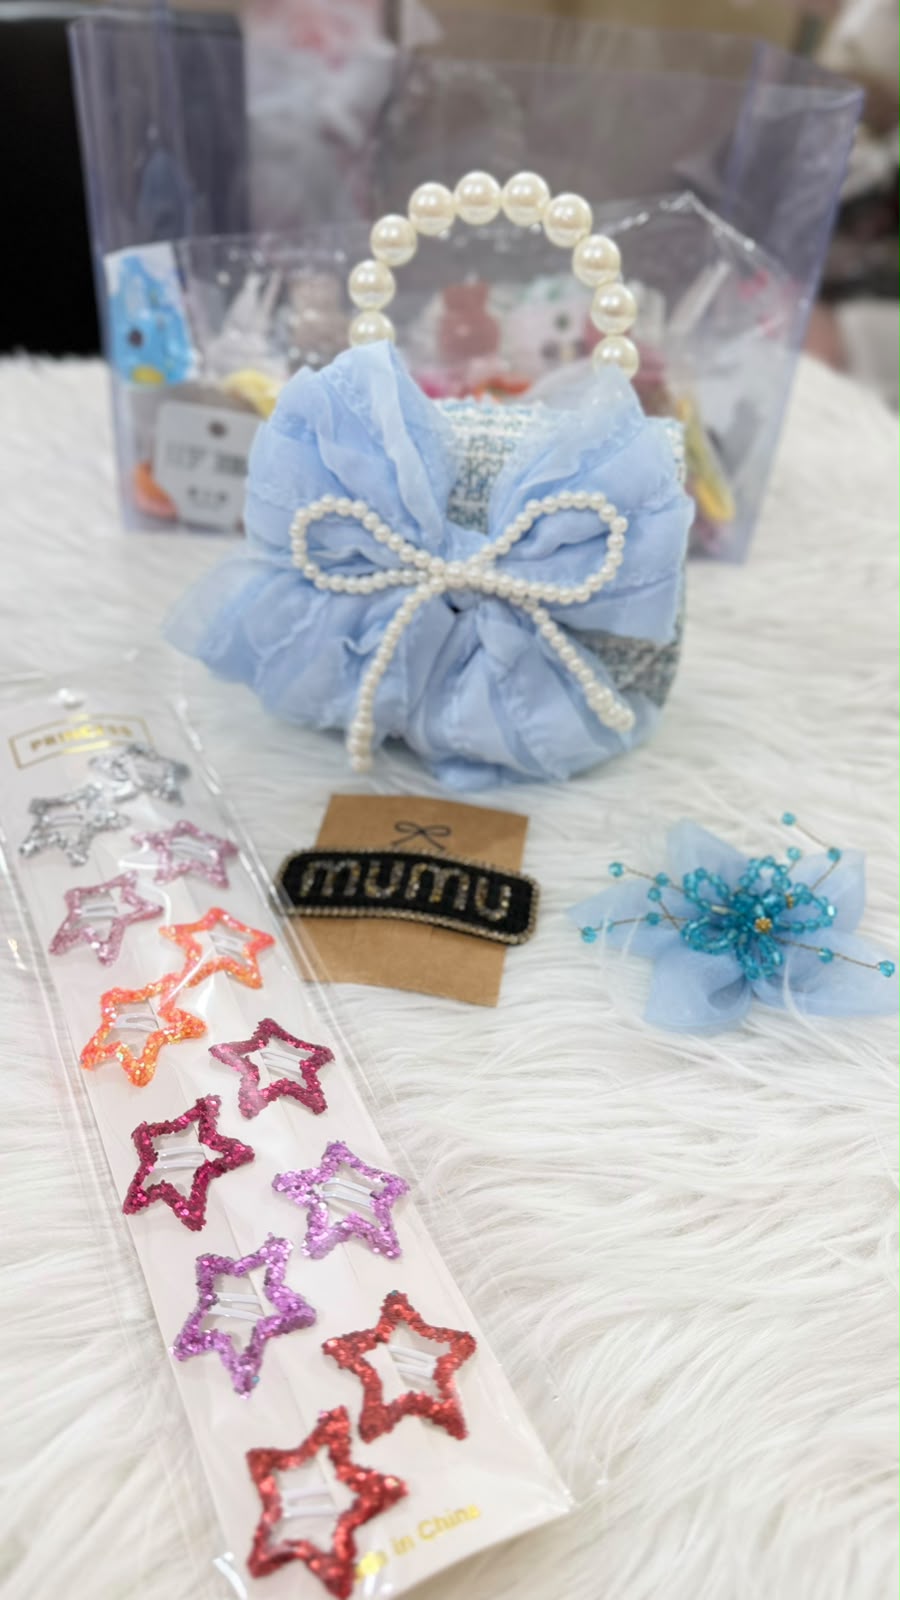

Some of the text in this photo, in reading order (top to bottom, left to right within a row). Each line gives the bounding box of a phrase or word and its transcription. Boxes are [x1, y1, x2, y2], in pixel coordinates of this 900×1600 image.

[300, 859, 512, 921] mumu
[391, 1504, 481, 1556] in China
